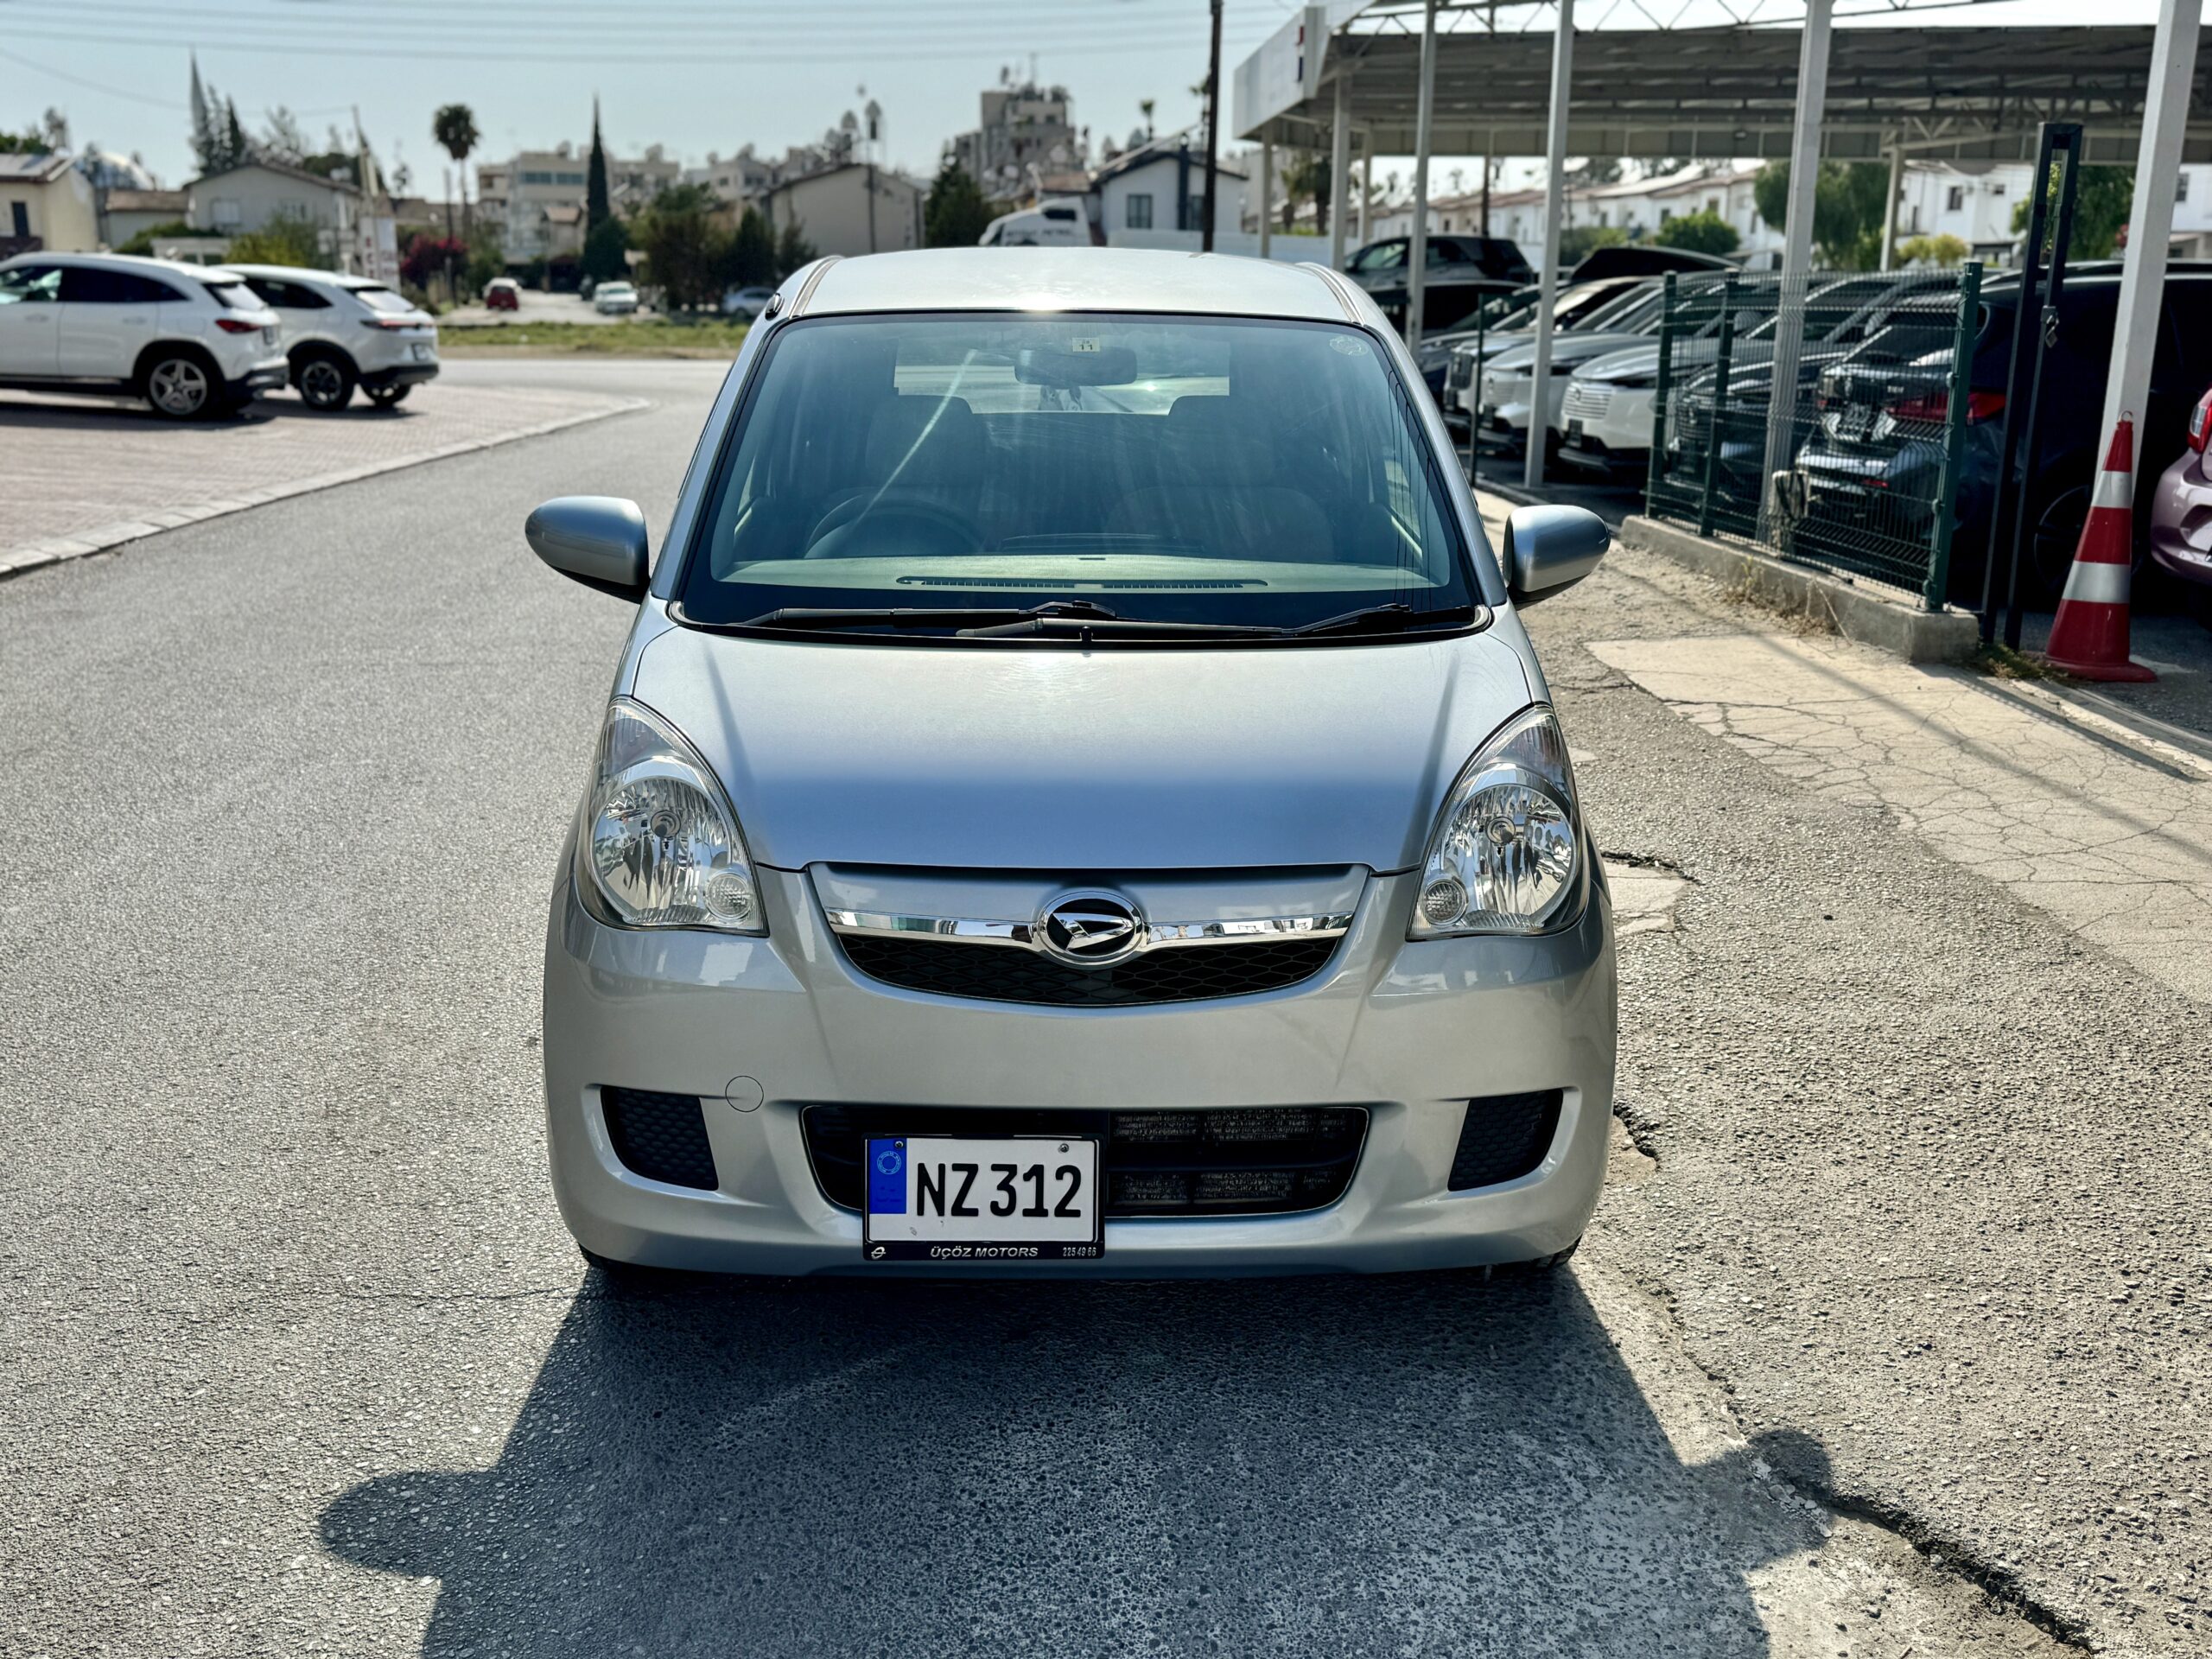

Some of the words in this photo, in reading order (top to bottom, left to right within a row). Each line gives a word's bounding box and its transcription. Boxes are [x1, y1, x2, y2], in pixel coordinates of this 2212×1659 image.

[917, 1163, 979, 1217] NZ
[990, 1164, 1081, 1217] 312
[931, 1246, 972, 1259] ÜÇÖZ
[975, 1247, 1039, 1257] MOTORS
